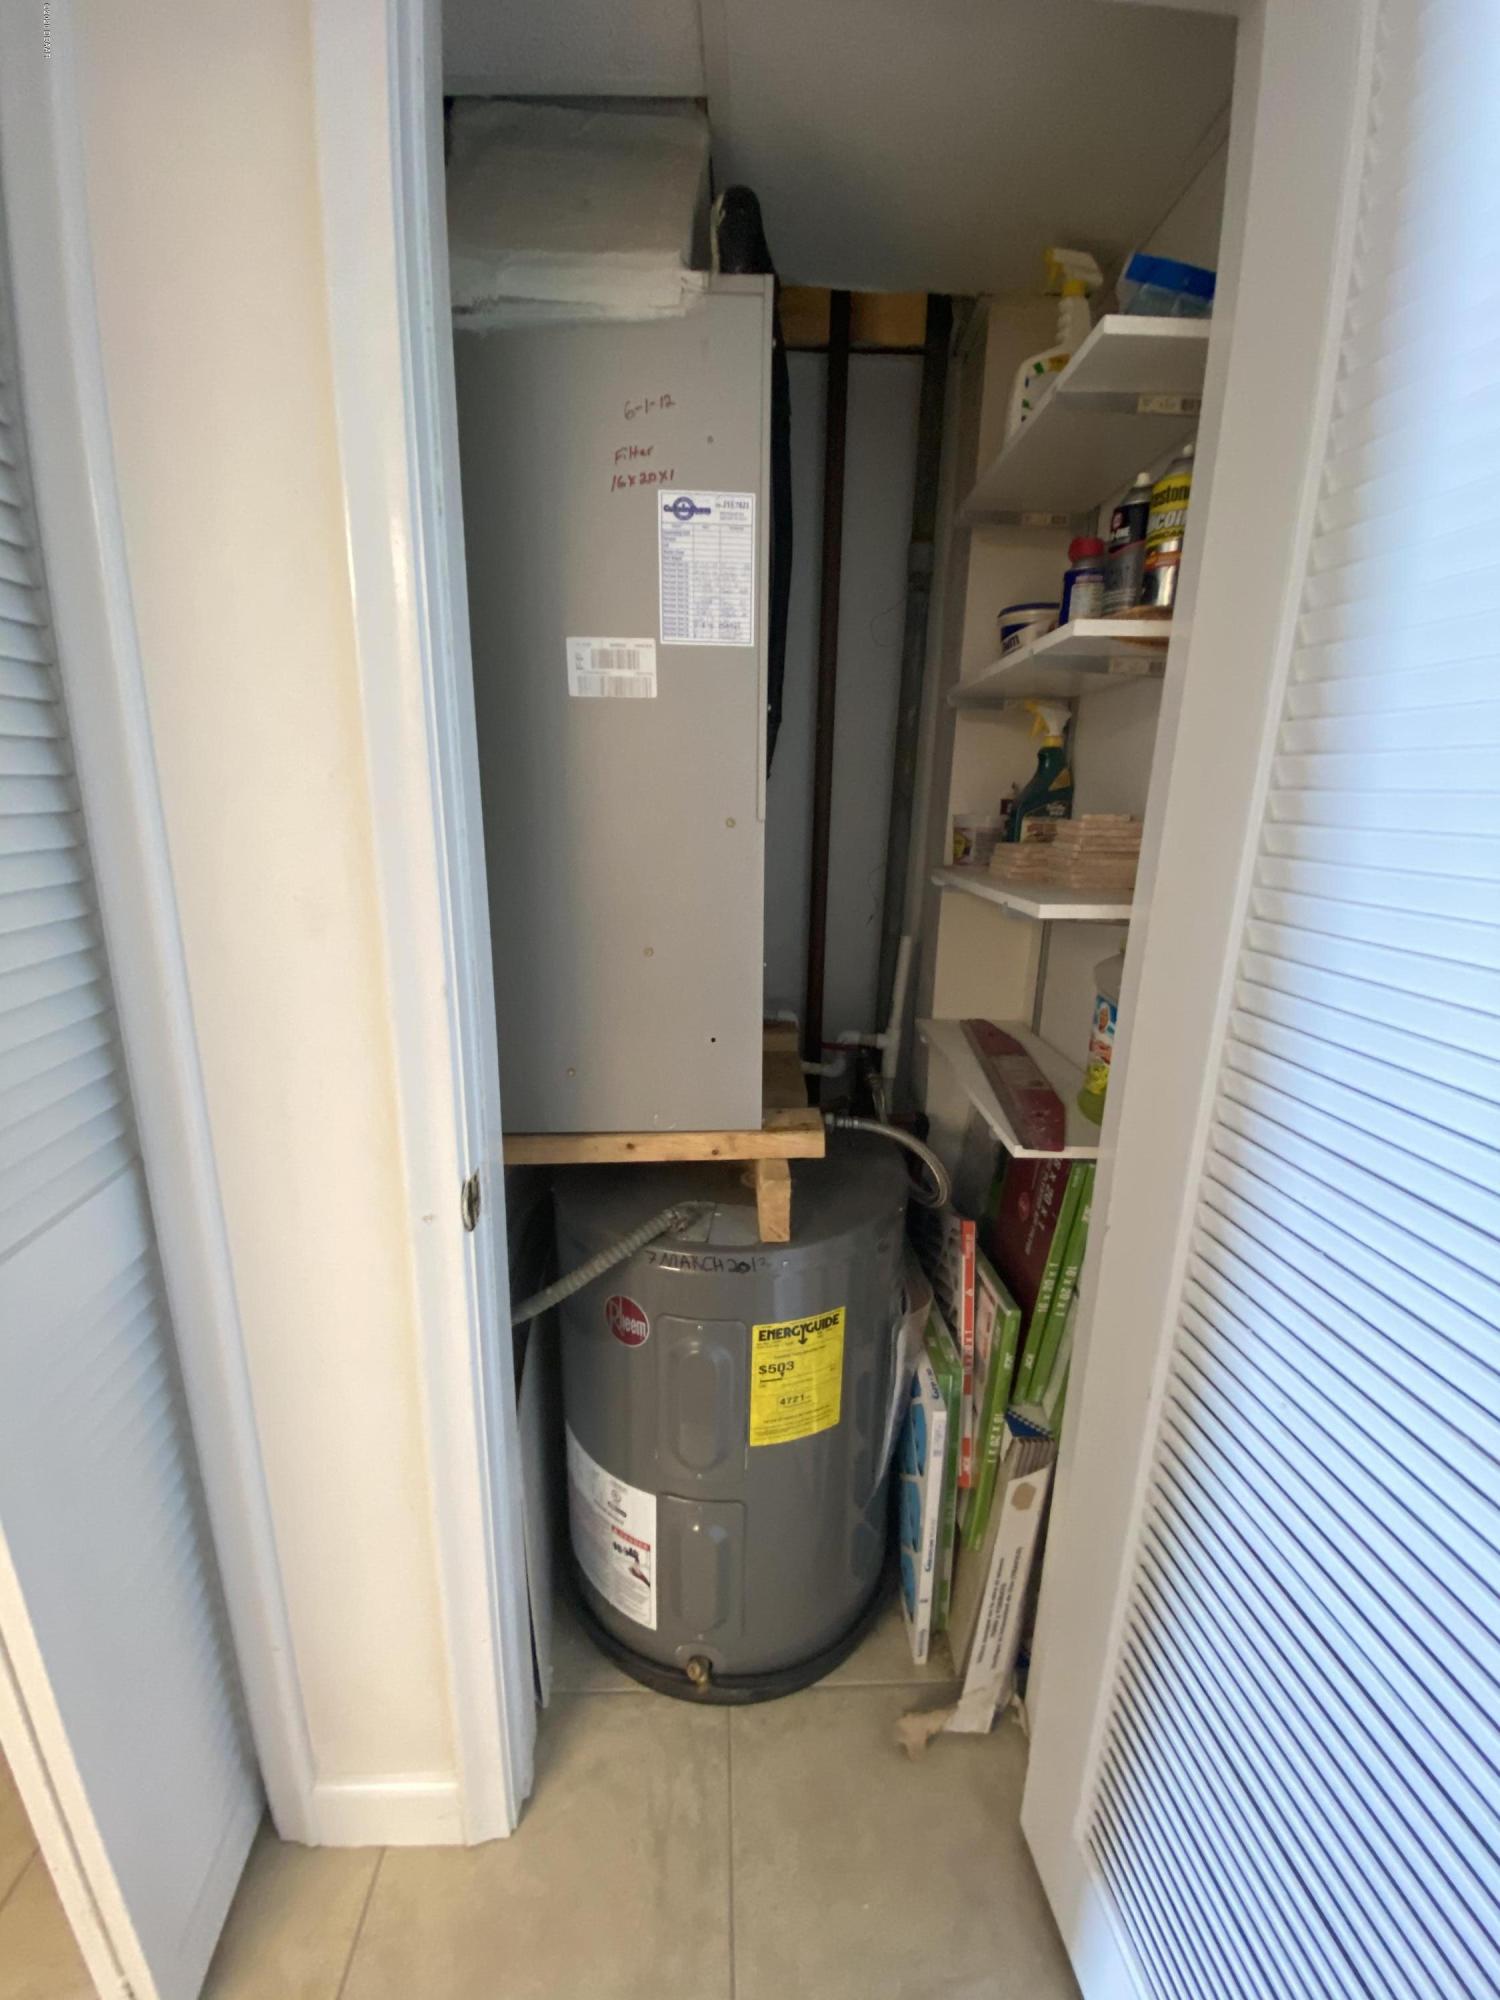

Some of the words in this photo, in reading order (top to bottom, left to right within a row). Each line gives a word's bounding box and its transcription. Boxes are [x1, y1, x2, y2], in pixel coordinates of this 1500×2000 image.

[623, 394, 675, 420] 6-1-12
[614, 445, 654, 465] Filter
[659, 1254, 724, 1272] MARCH
[608, 1296, 647, 1337] Rheem
